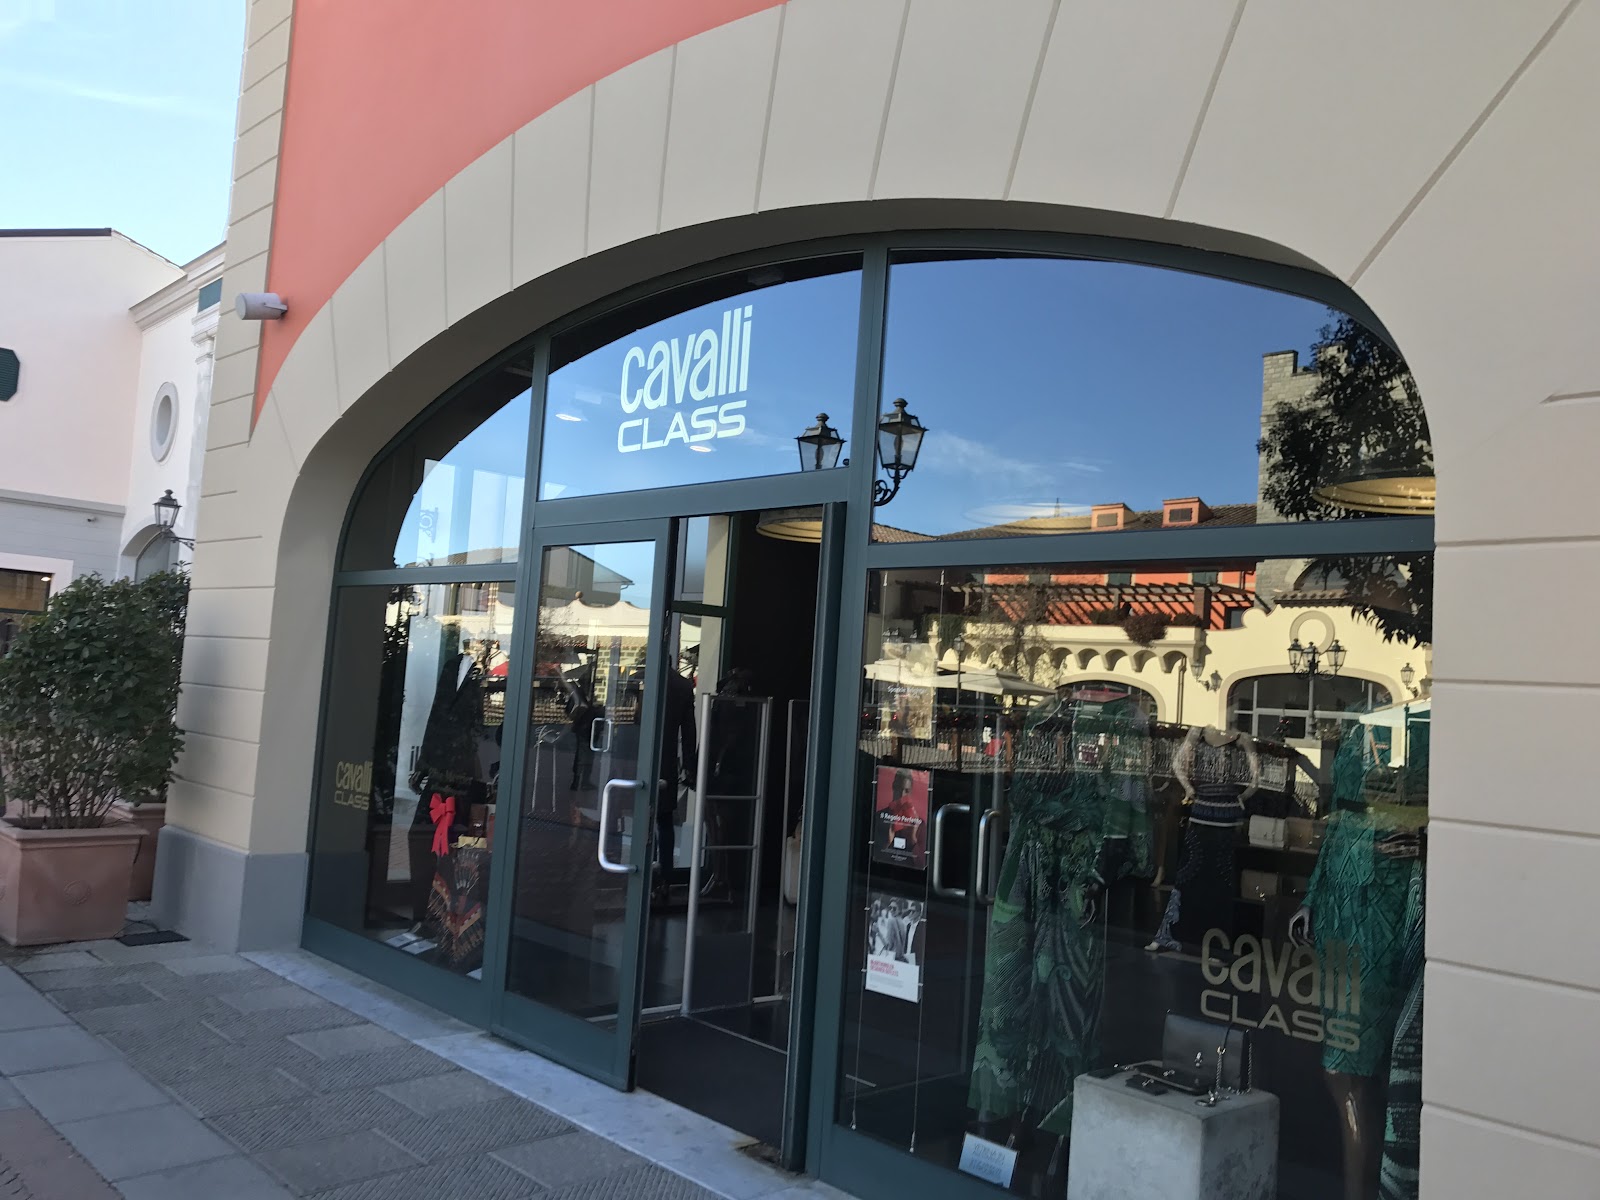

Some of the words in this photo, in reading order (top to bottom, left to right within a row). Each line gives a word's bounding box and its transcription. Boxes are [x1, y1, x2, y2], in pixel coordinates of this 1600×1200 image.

[621, 305, 752, 413] cavalli
[618, 400, 747, 453] CLASS
[334, 790, 370, 810] CLASS
[335, 761, 373, 794] cavalli
[1202, 928, 1361, 1015] cavalli
[1201, 989, 1361, 1052] CLASS
